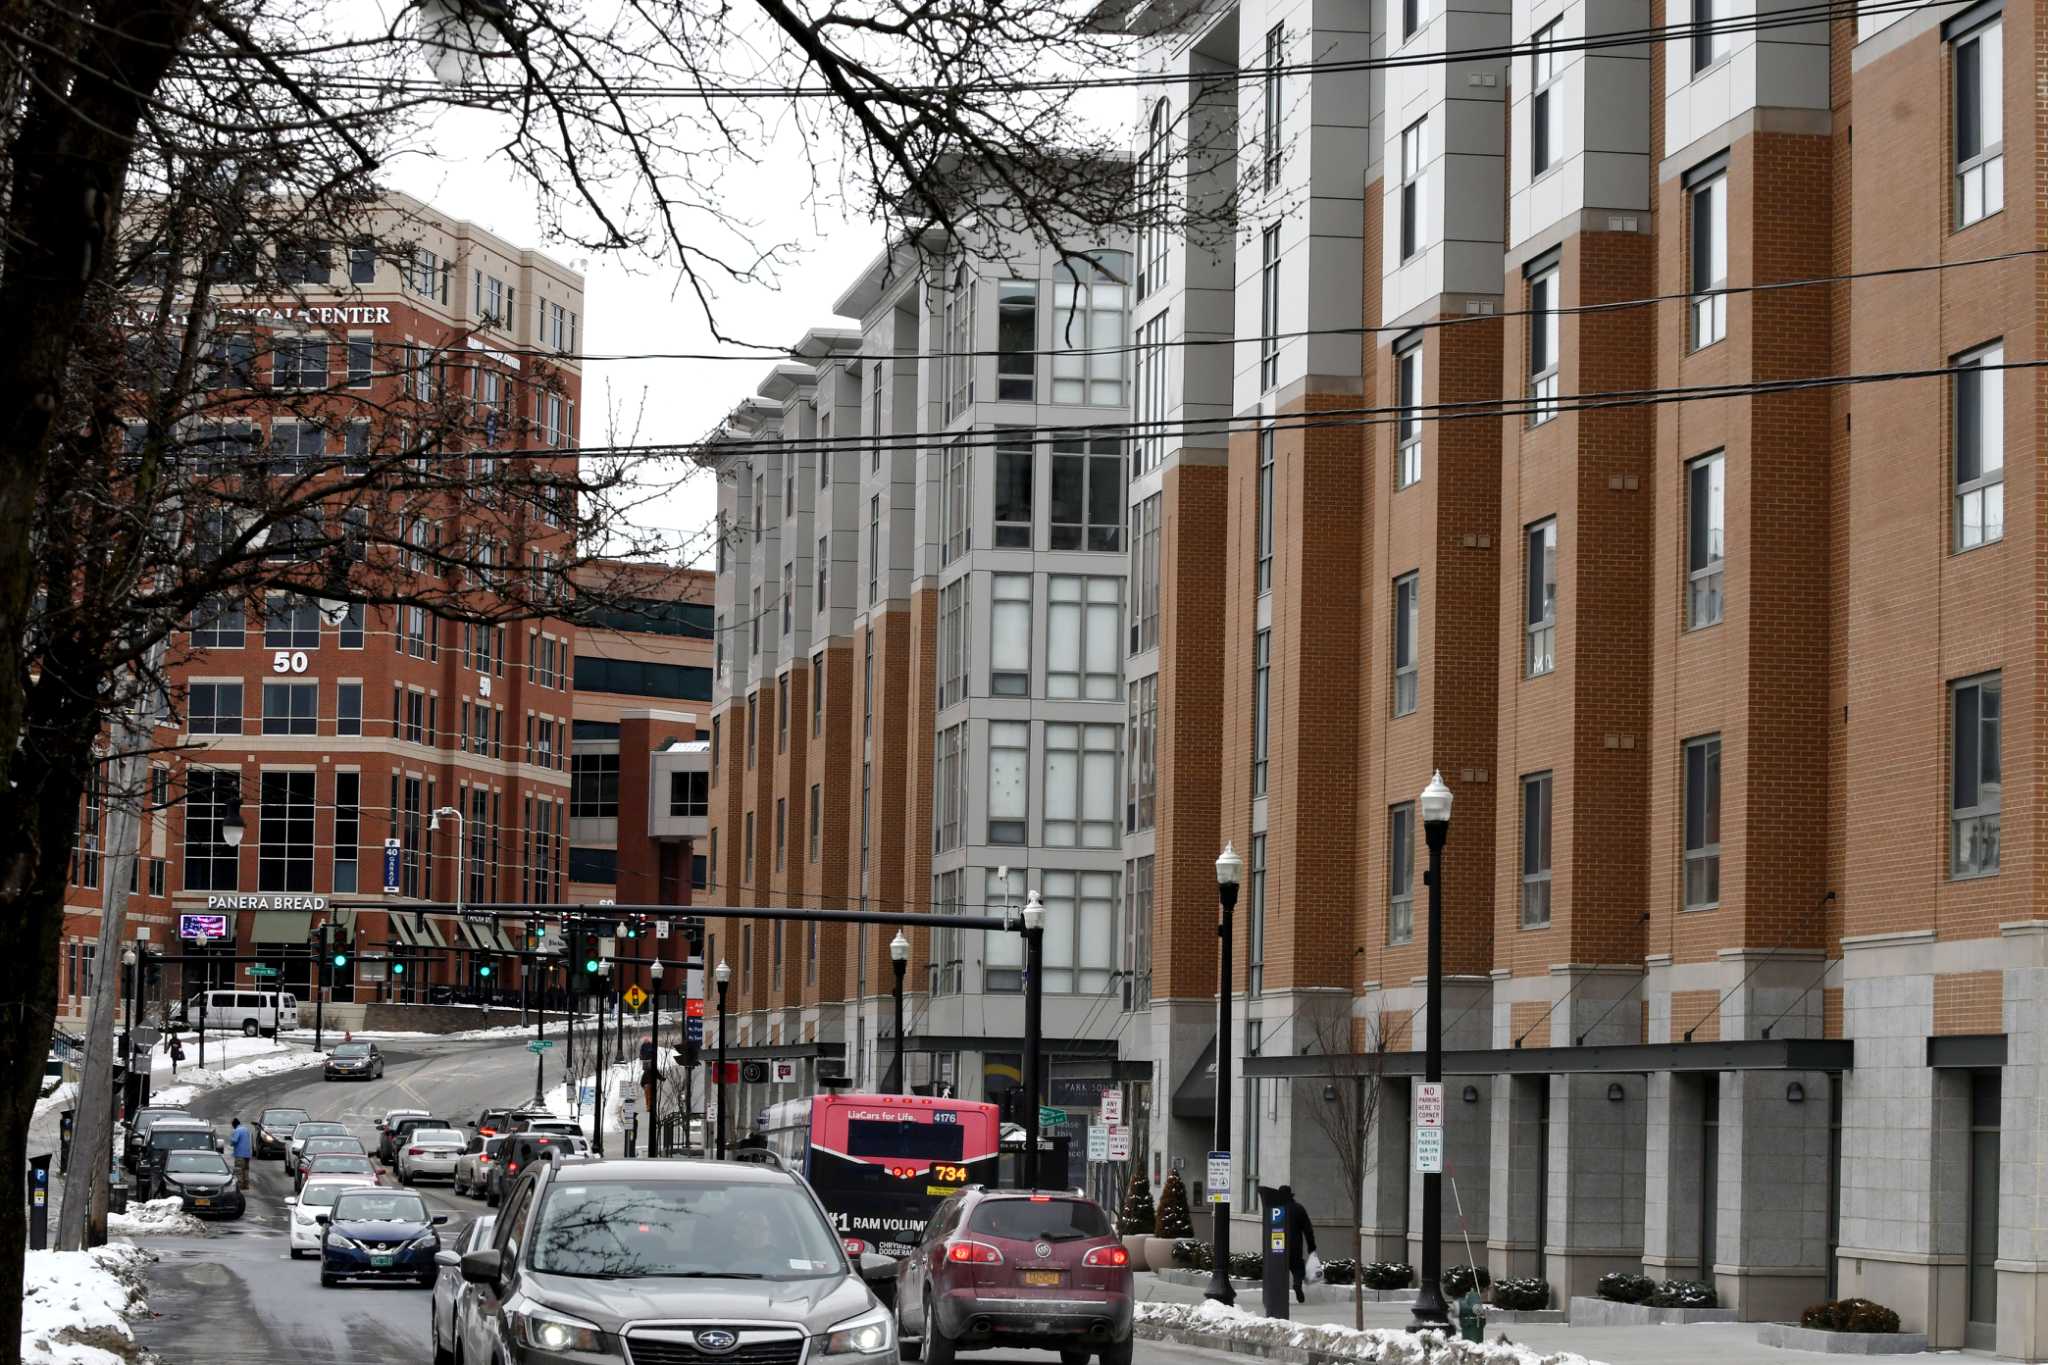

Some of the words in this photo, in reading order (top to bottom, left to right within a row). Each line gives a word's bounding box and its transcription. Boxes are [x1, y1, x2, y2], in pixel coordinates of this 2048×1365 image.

[305, 307, 391, 324] CENTER
[272, 651, 308, 673] 50
[387, 848, 398, 856] 40
[388, 856, 396, 885] GARAGE
[208, 895, 269, 909] PANERA
[274, 897, 326, 910] BREAD
[1424, 1087, 1435, 1096] NO
[848, 1110, 880, 1120] LiaCars
[882, 1111, 895, 1120] for
[897, 1111, 917, 1121] Life.
[934, 1112, 957, 1123] 4176
[935, 1166, 967, 1182] 734
[828, 1212, 851, 1231] #1
[853, 1217, 881, 1229] RAM
[1272, 1207, 1281, 1221] P
